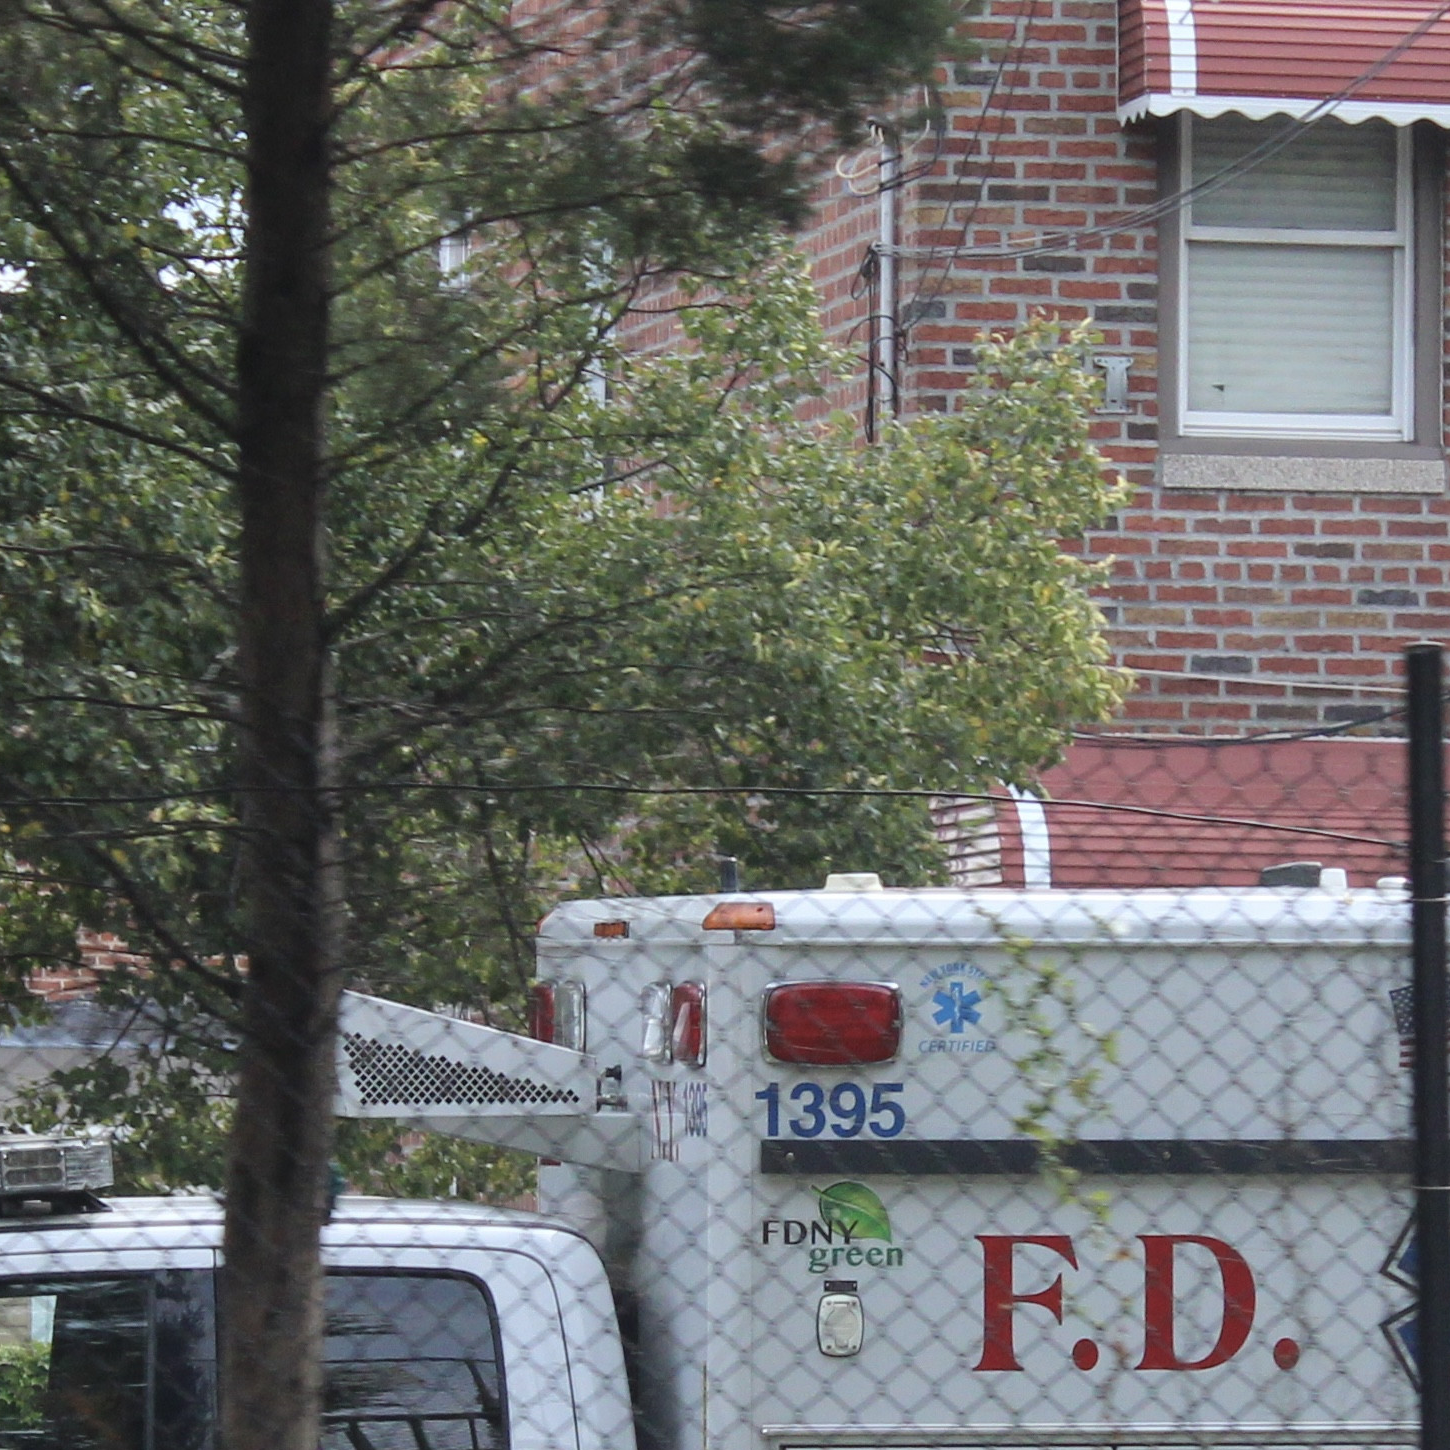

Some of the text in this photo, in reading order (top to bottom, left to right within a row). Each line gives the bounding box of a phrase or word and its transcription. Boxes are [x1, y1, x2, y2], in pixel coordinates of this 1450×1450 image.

[918, 1040, 997, 1053] CERTIFIED
[754, 1082, 906, 1138] 1395
[762, 1220, 859, 1245] FDNY
[808, 1246, 903, 1274] green
[972, 1234, 1299, 1371] F.D.
